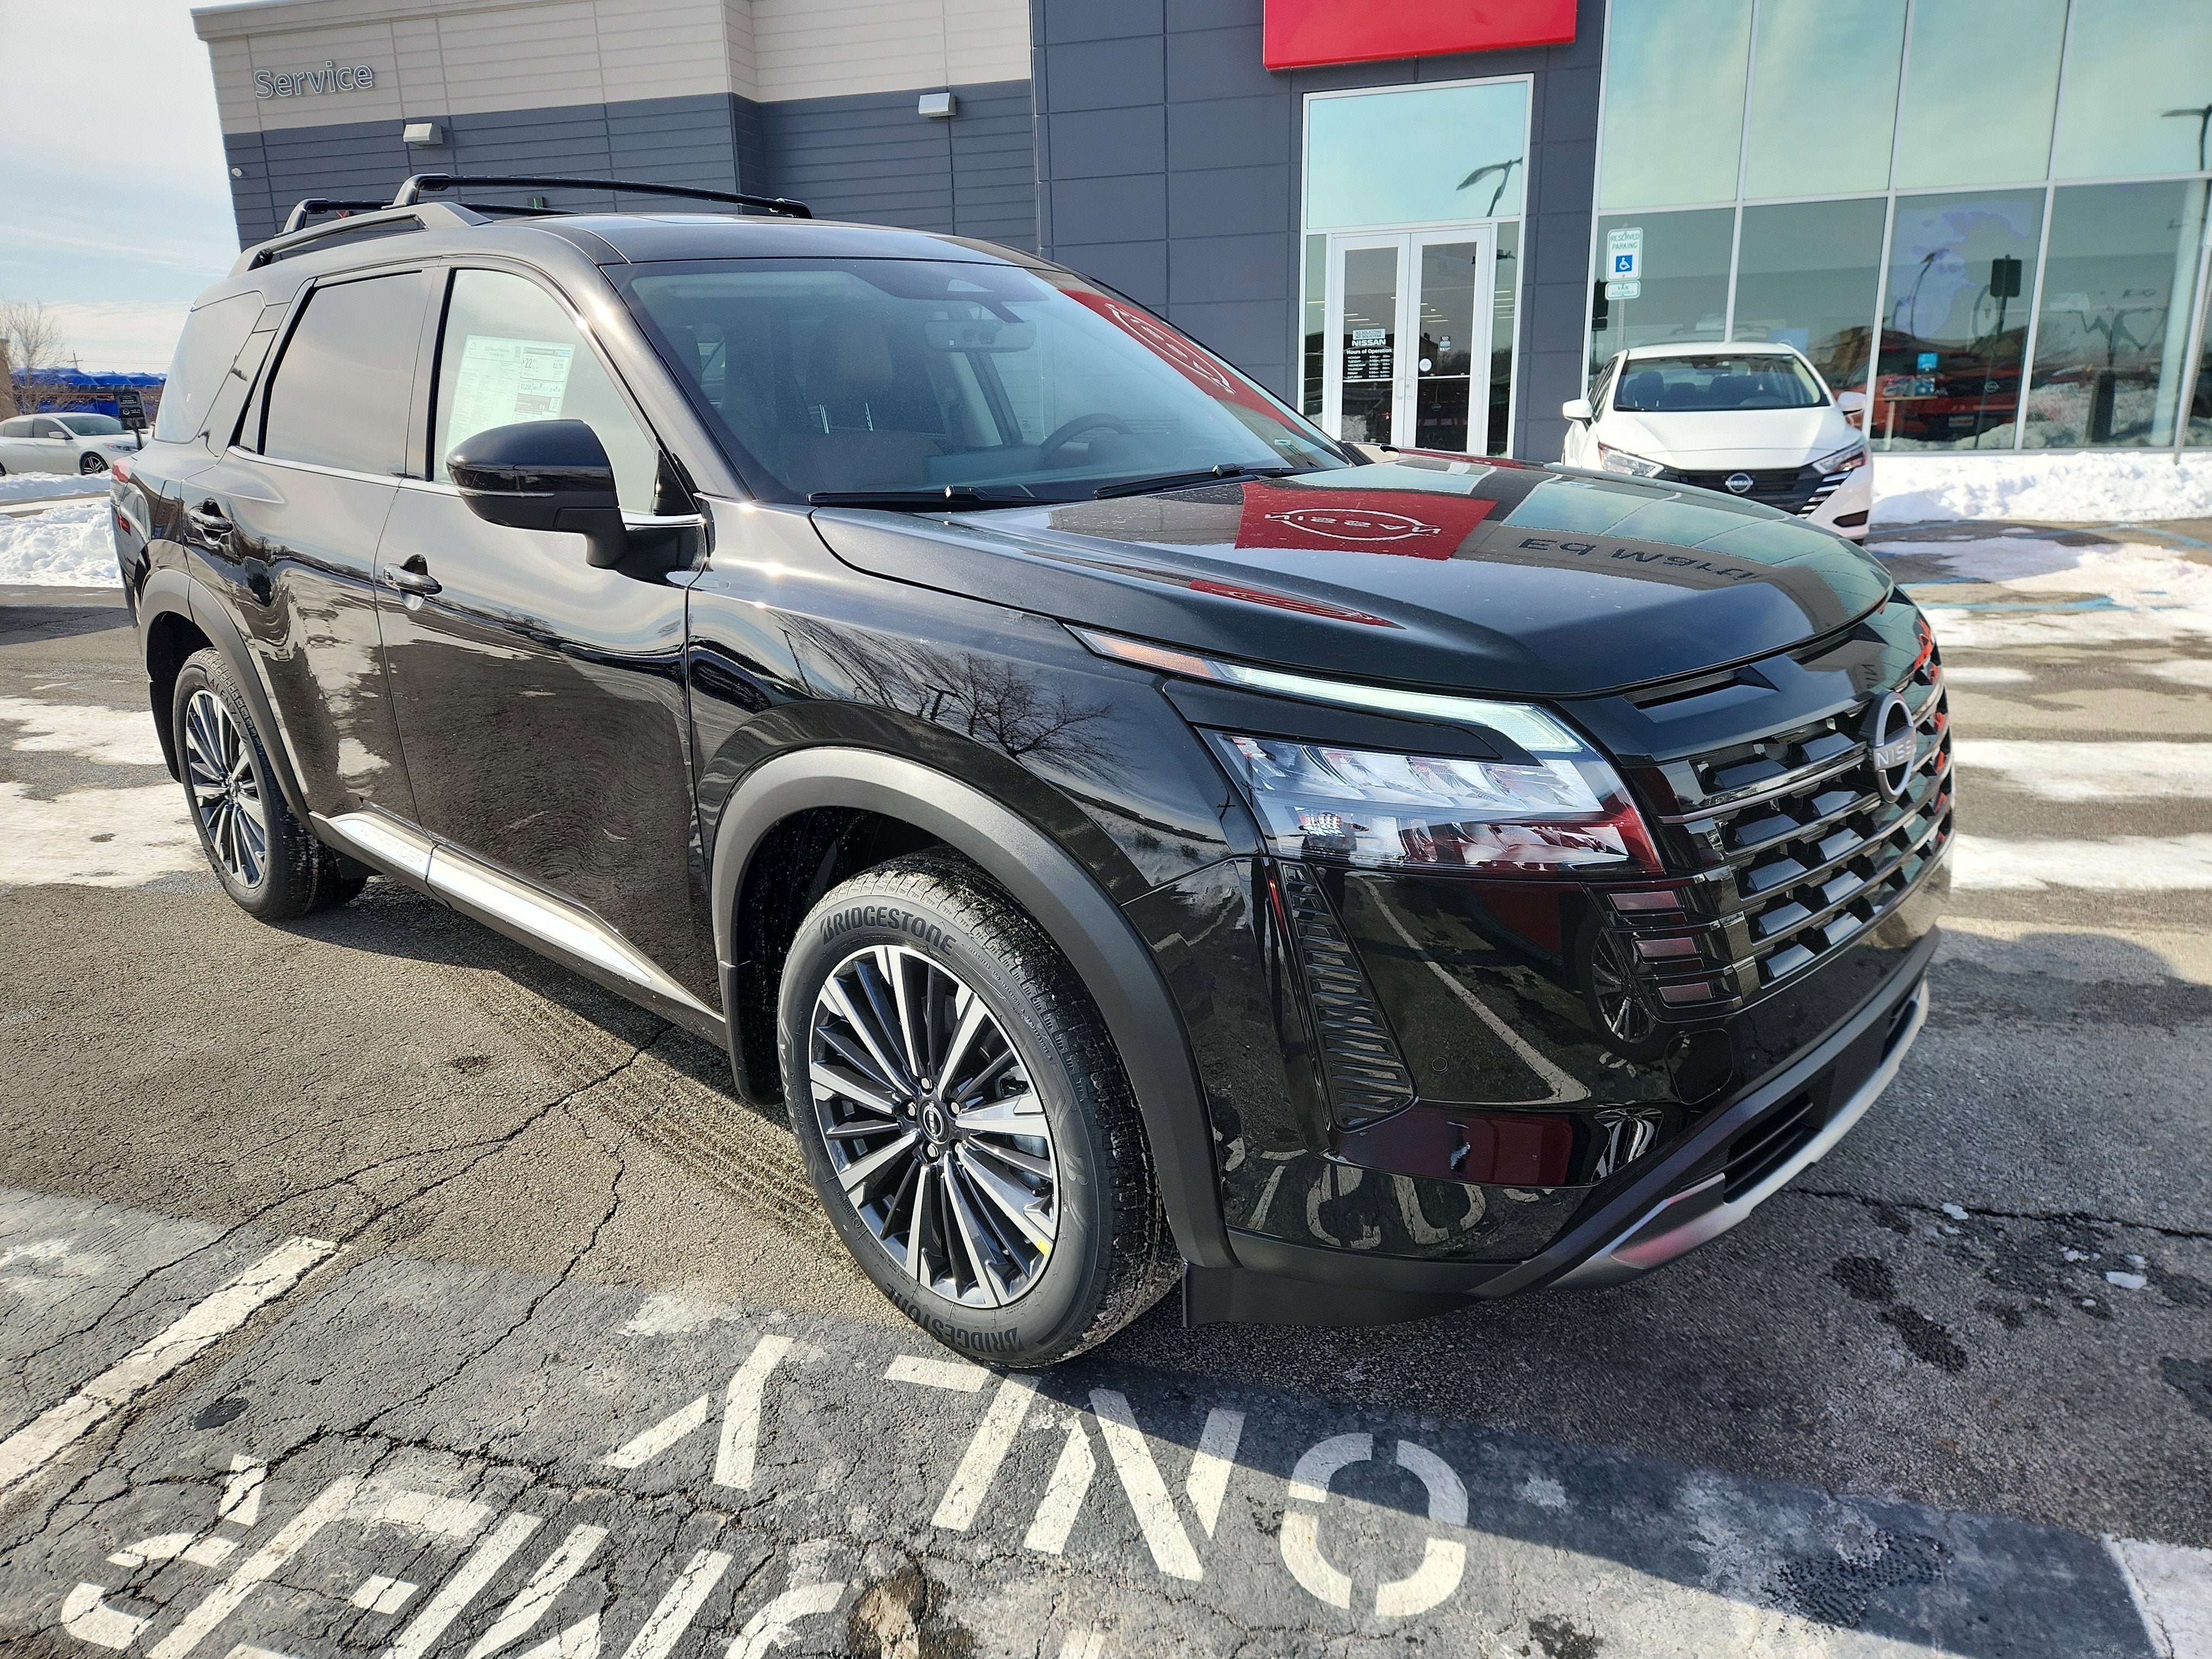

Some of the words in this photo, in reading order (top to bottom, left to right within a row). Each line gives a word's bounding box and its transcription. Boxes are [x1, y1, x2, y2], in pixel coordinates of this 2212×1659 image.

[253, 61, 374, 98] Service
[1610, 233, 1640, 242] RESERVED
[1612, 242, 1637, 250] PARKING
[525, 358, 533, 369] 22
[1876, 739, 1912, 768] NISS
[820, 905, 957, 956] BRIDGESTONE
[884, 1282, 1026, 1353] BRIDGESTONE
[601, 1334, 1470, 1617] ONLY
